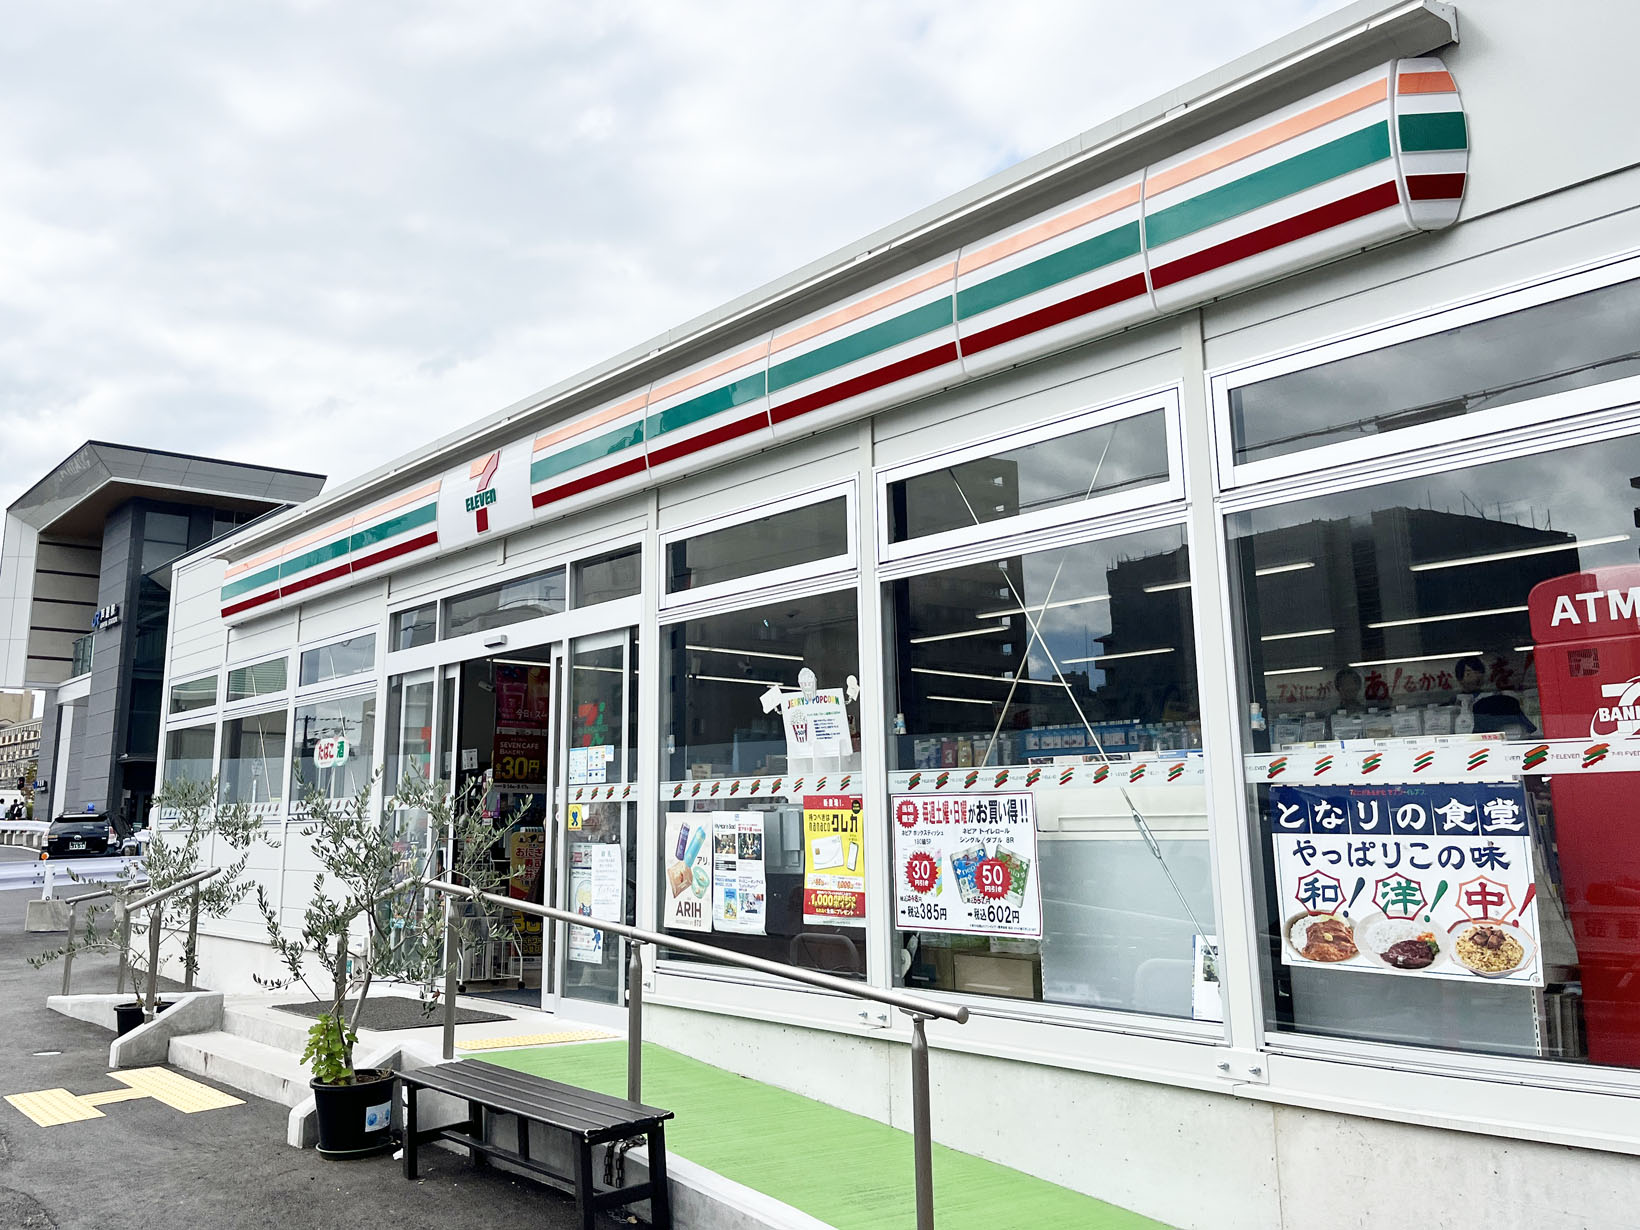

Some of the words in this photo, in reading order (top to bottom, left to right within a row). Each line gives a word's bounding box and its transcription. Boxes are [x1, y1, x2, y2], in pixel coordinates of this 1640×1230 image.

[1551, 587, 1640, 627] ATM
[1599, 706, 1640, 723] BAN
[318, 742, 334, 760] たばこ
[500, 741, 521, 749] SEVEN
[832, 814, 857, 832] クレカ
[1277, 797, 1525, 832] となりの食堂
[1293, 839, 1511, 870] やっぱりこの味
[912, 860, 930, 879] 30
[982, 865, 1003, 885] 50
[984, 885, 1003, 893] 円引き
[676, 900, 702, 919] ARIH
[908, 903, 947, 920] 税込385円
[974, 905, 1020, 923] 税込602円
